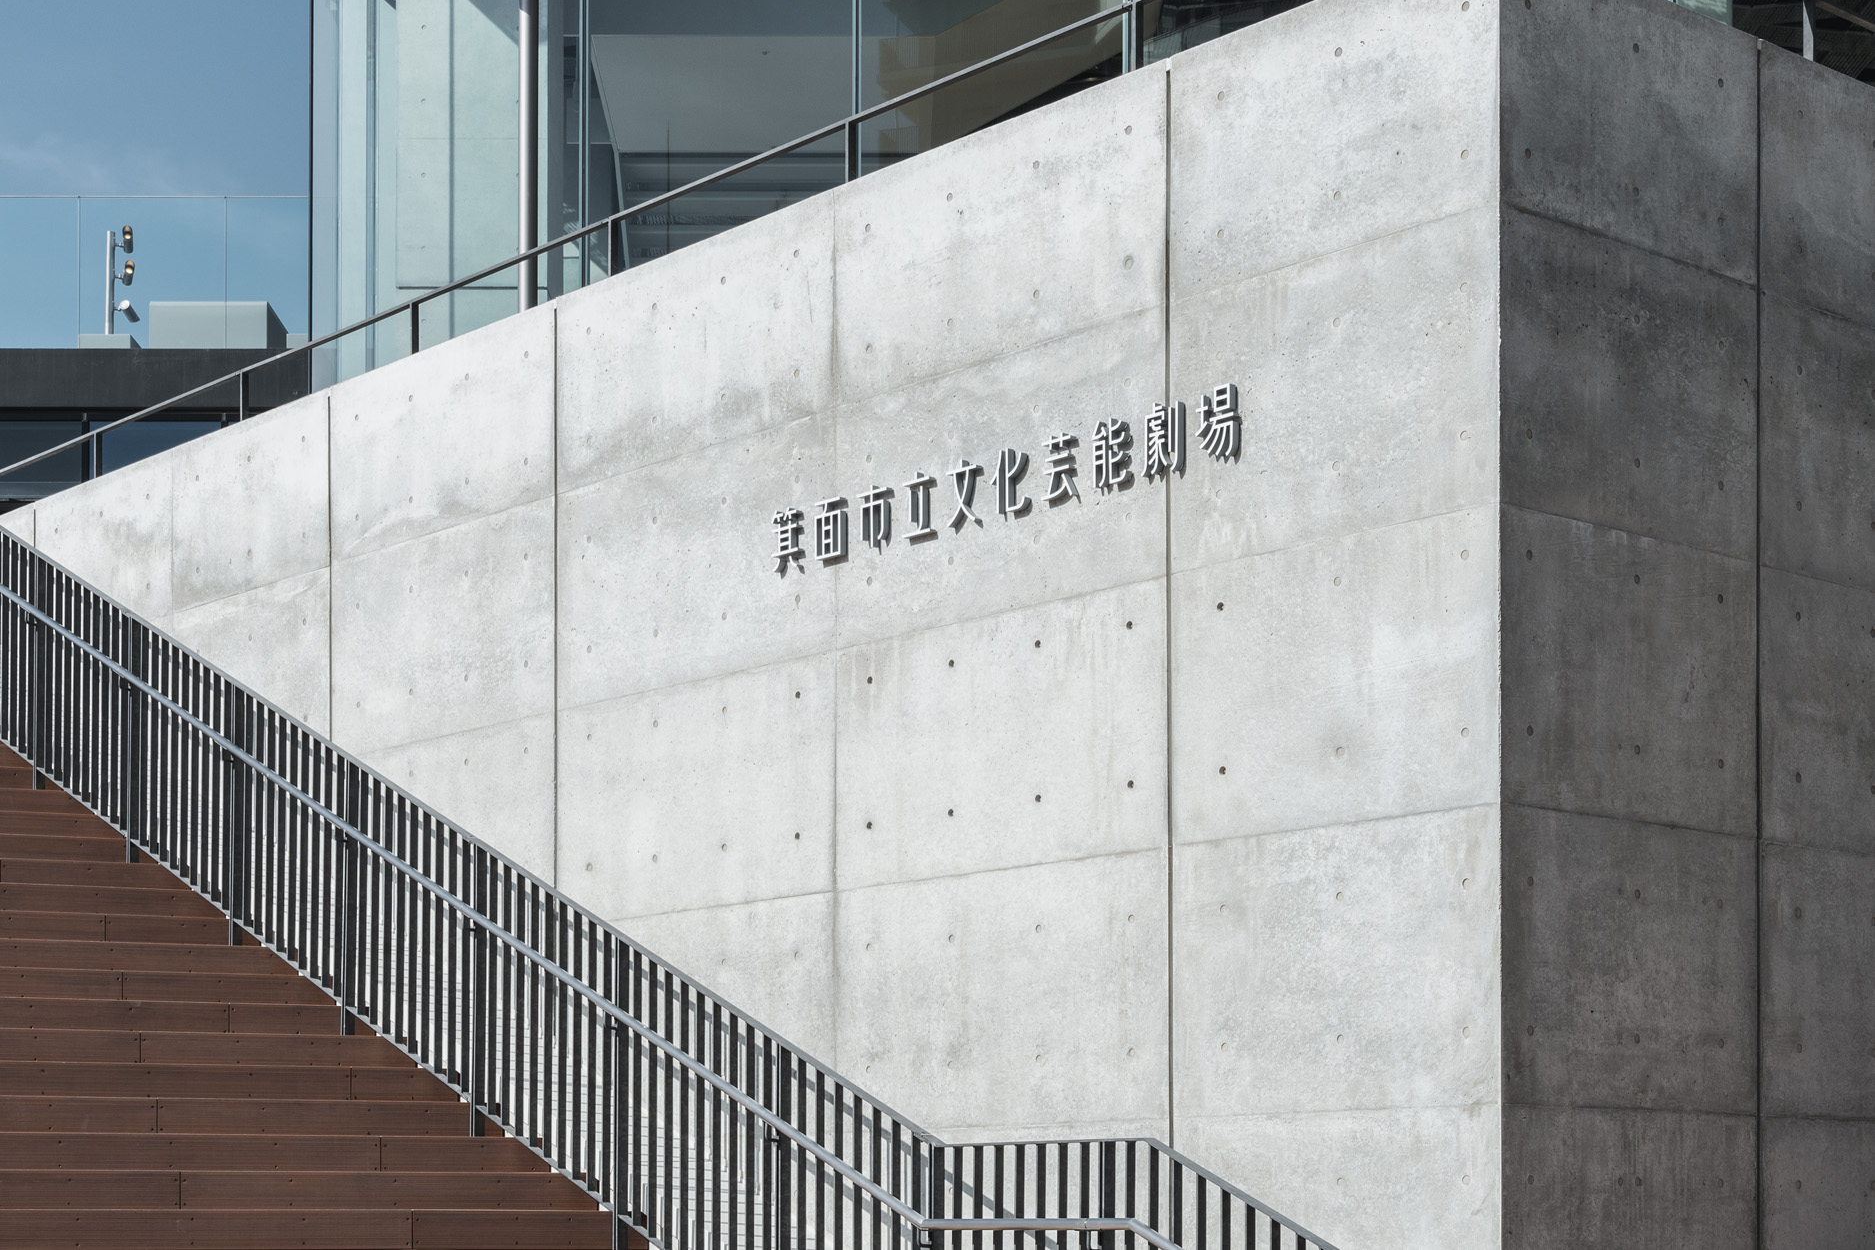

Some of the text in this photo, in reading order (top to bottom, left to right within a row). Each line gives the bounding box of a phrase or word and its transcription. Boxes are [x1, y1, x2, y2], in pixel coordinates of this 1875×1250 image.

[772, 382, 1240, 576] 箕面市立文化芸能劇場
